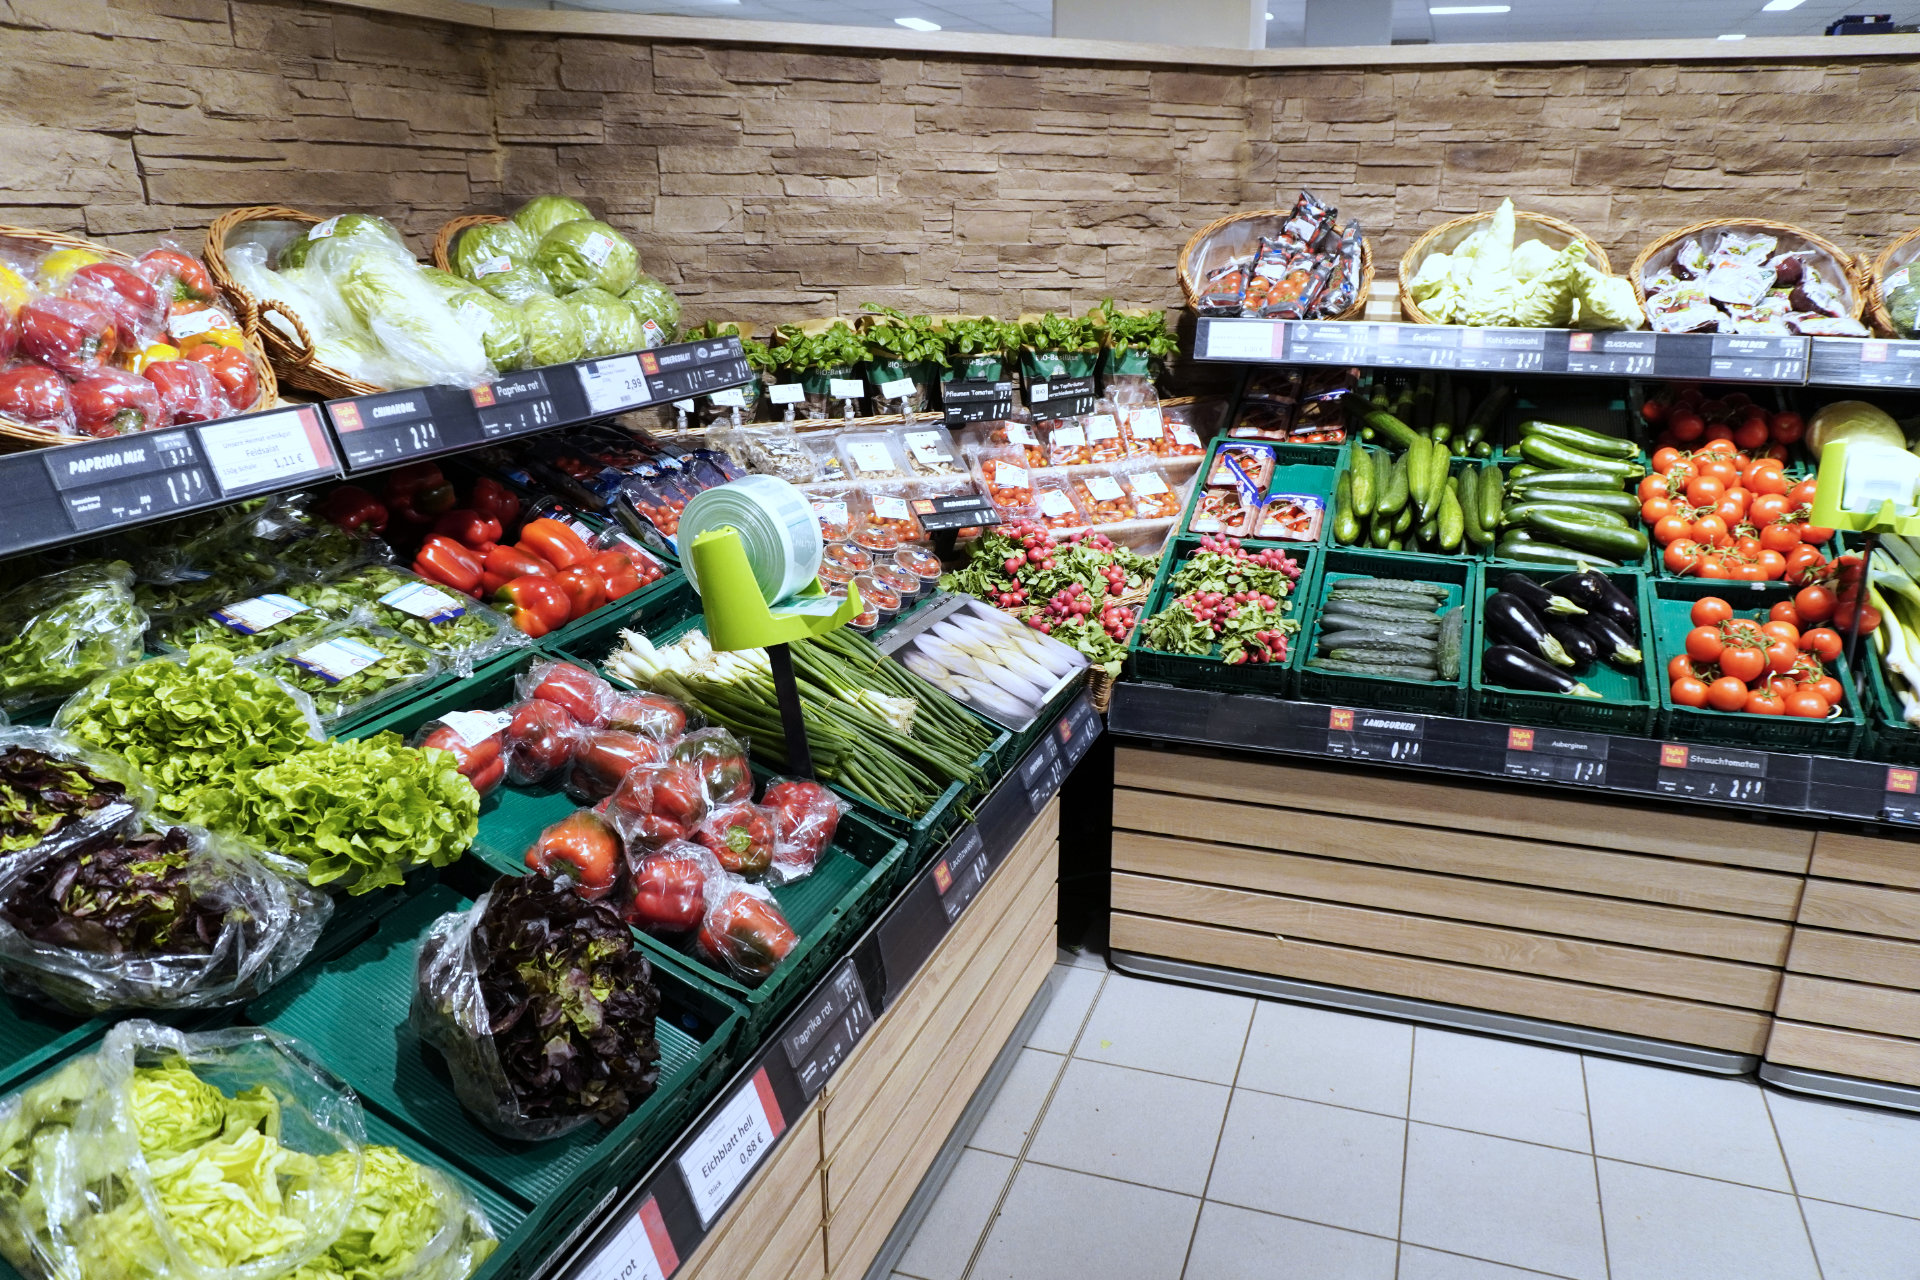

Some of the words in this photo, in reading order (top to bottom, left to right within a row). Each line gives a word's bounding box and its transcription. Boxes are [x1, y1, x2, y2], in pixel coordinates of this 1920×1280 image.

[1486, 336, 1502, 345] Kohl
[1504, 336, 1539, 348] Spitzkohl
[496, 382, 528, 398] Paprika
[527, 380, 540, 391] rot
[624, 377, 642, 390] 2,99
[945, 390, 970, 398] Pflaumen
[372, 401, 417, 418] CHINAKOHL
[245, 444, 281, 457] Feldsalat
[68, 452, 123, 476] PAPRIKA
[123, 448, 146, 465] MIX
[273, 455, 296, 469] 1,11
[296, 452, 305, 464] €
[1362, 718, 1417, 732] LANDGURKEN
[1551, 740, 1588, 751] Auberginen
[1689, 754, 1761, 769] Strauchtomaten
[1574, 762, 1604, 781] 1.29
[793, 1015, 823, 1051] Paprika
[821, 1000, 834, 1021] rot
[700, 1132, 739, 1179] Eichblatt
[738, 1114, 755, 1139] hell
[707, 1179, 722, 1198] Stück
[739, 1139, 758, 1166] 0,88
[757, 1131, 765, 1144] €
